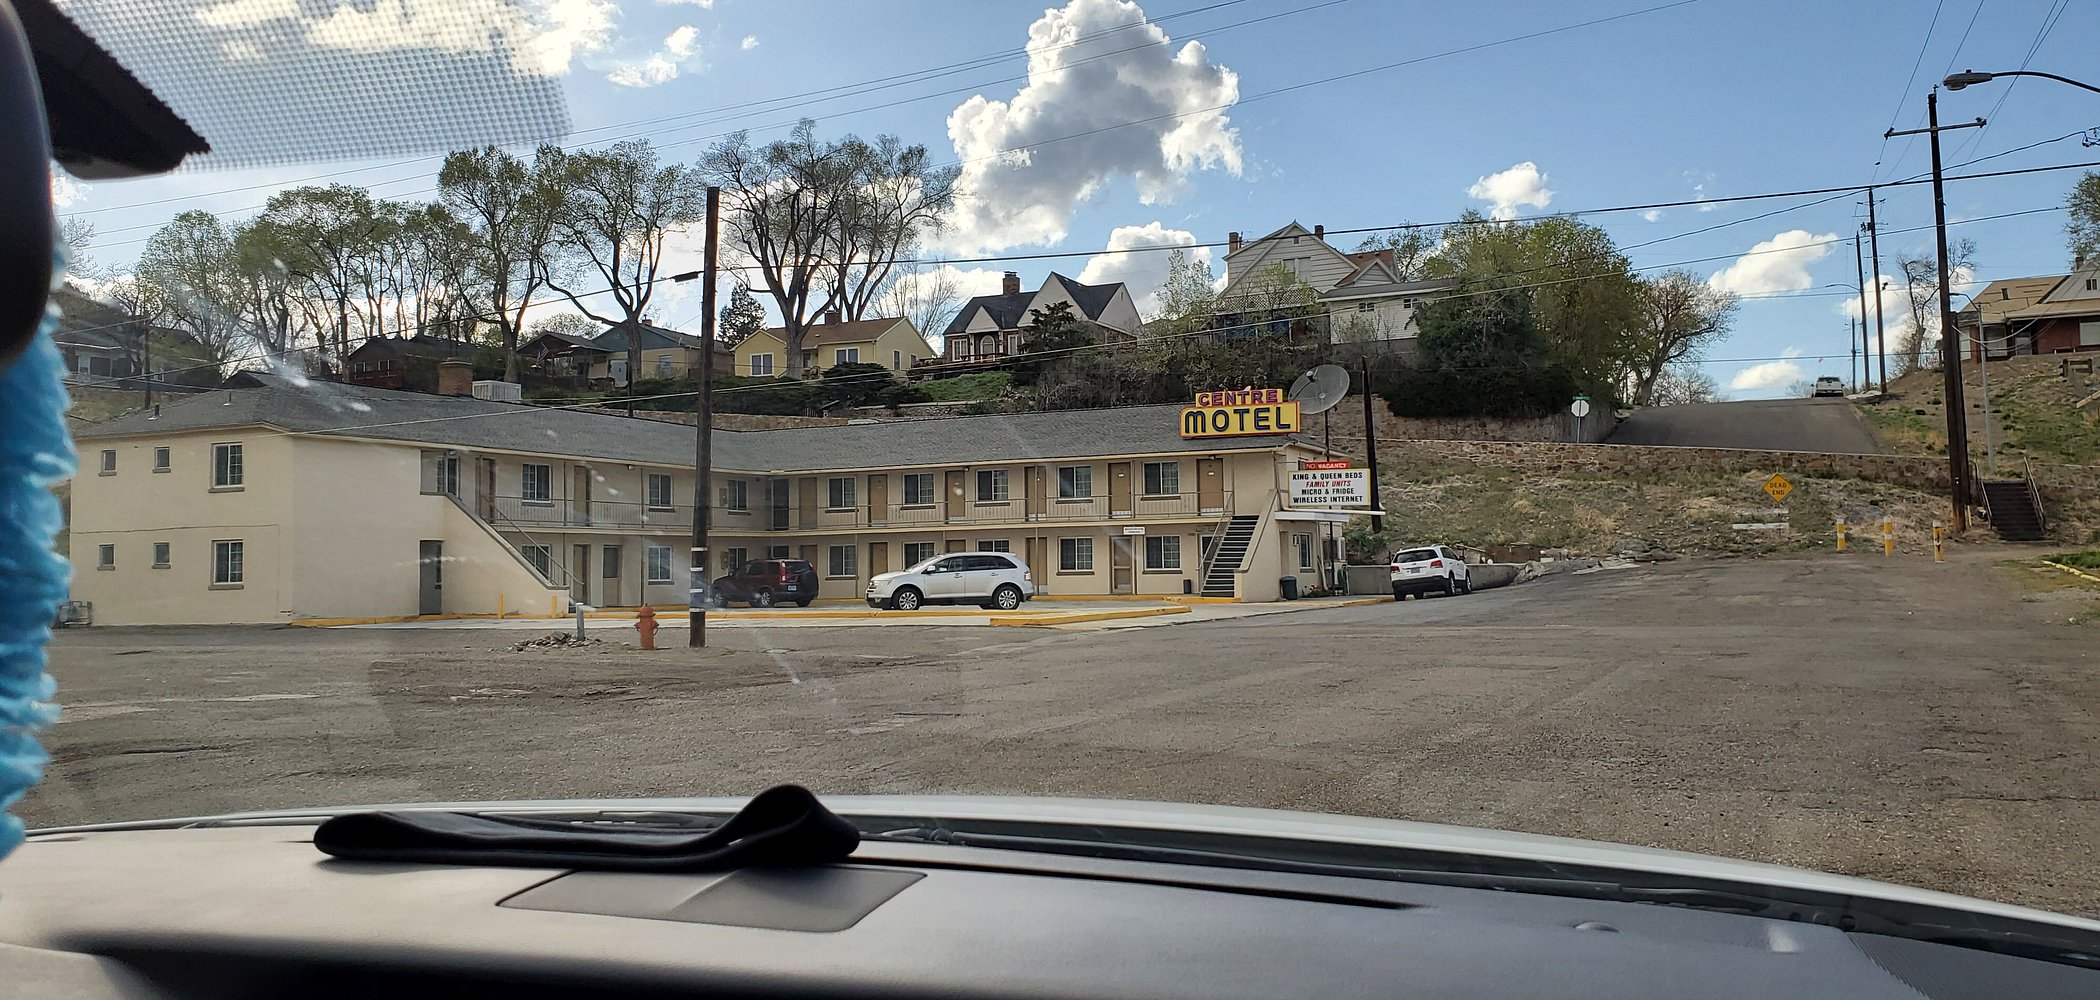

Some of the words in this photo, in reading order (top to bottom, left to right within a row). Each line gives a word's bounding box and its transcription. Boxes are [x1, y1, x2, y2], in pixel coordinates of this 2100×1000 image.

[1198, 389, 1278, 406] CENTRE
[1184, 406, 1291, 434] MOTEL
[1320, 472, 1342, 480] QUEEN
[1305, 480, 1330, 488] FAMILY
[1330, 495, 1363, 503] INTERNET
